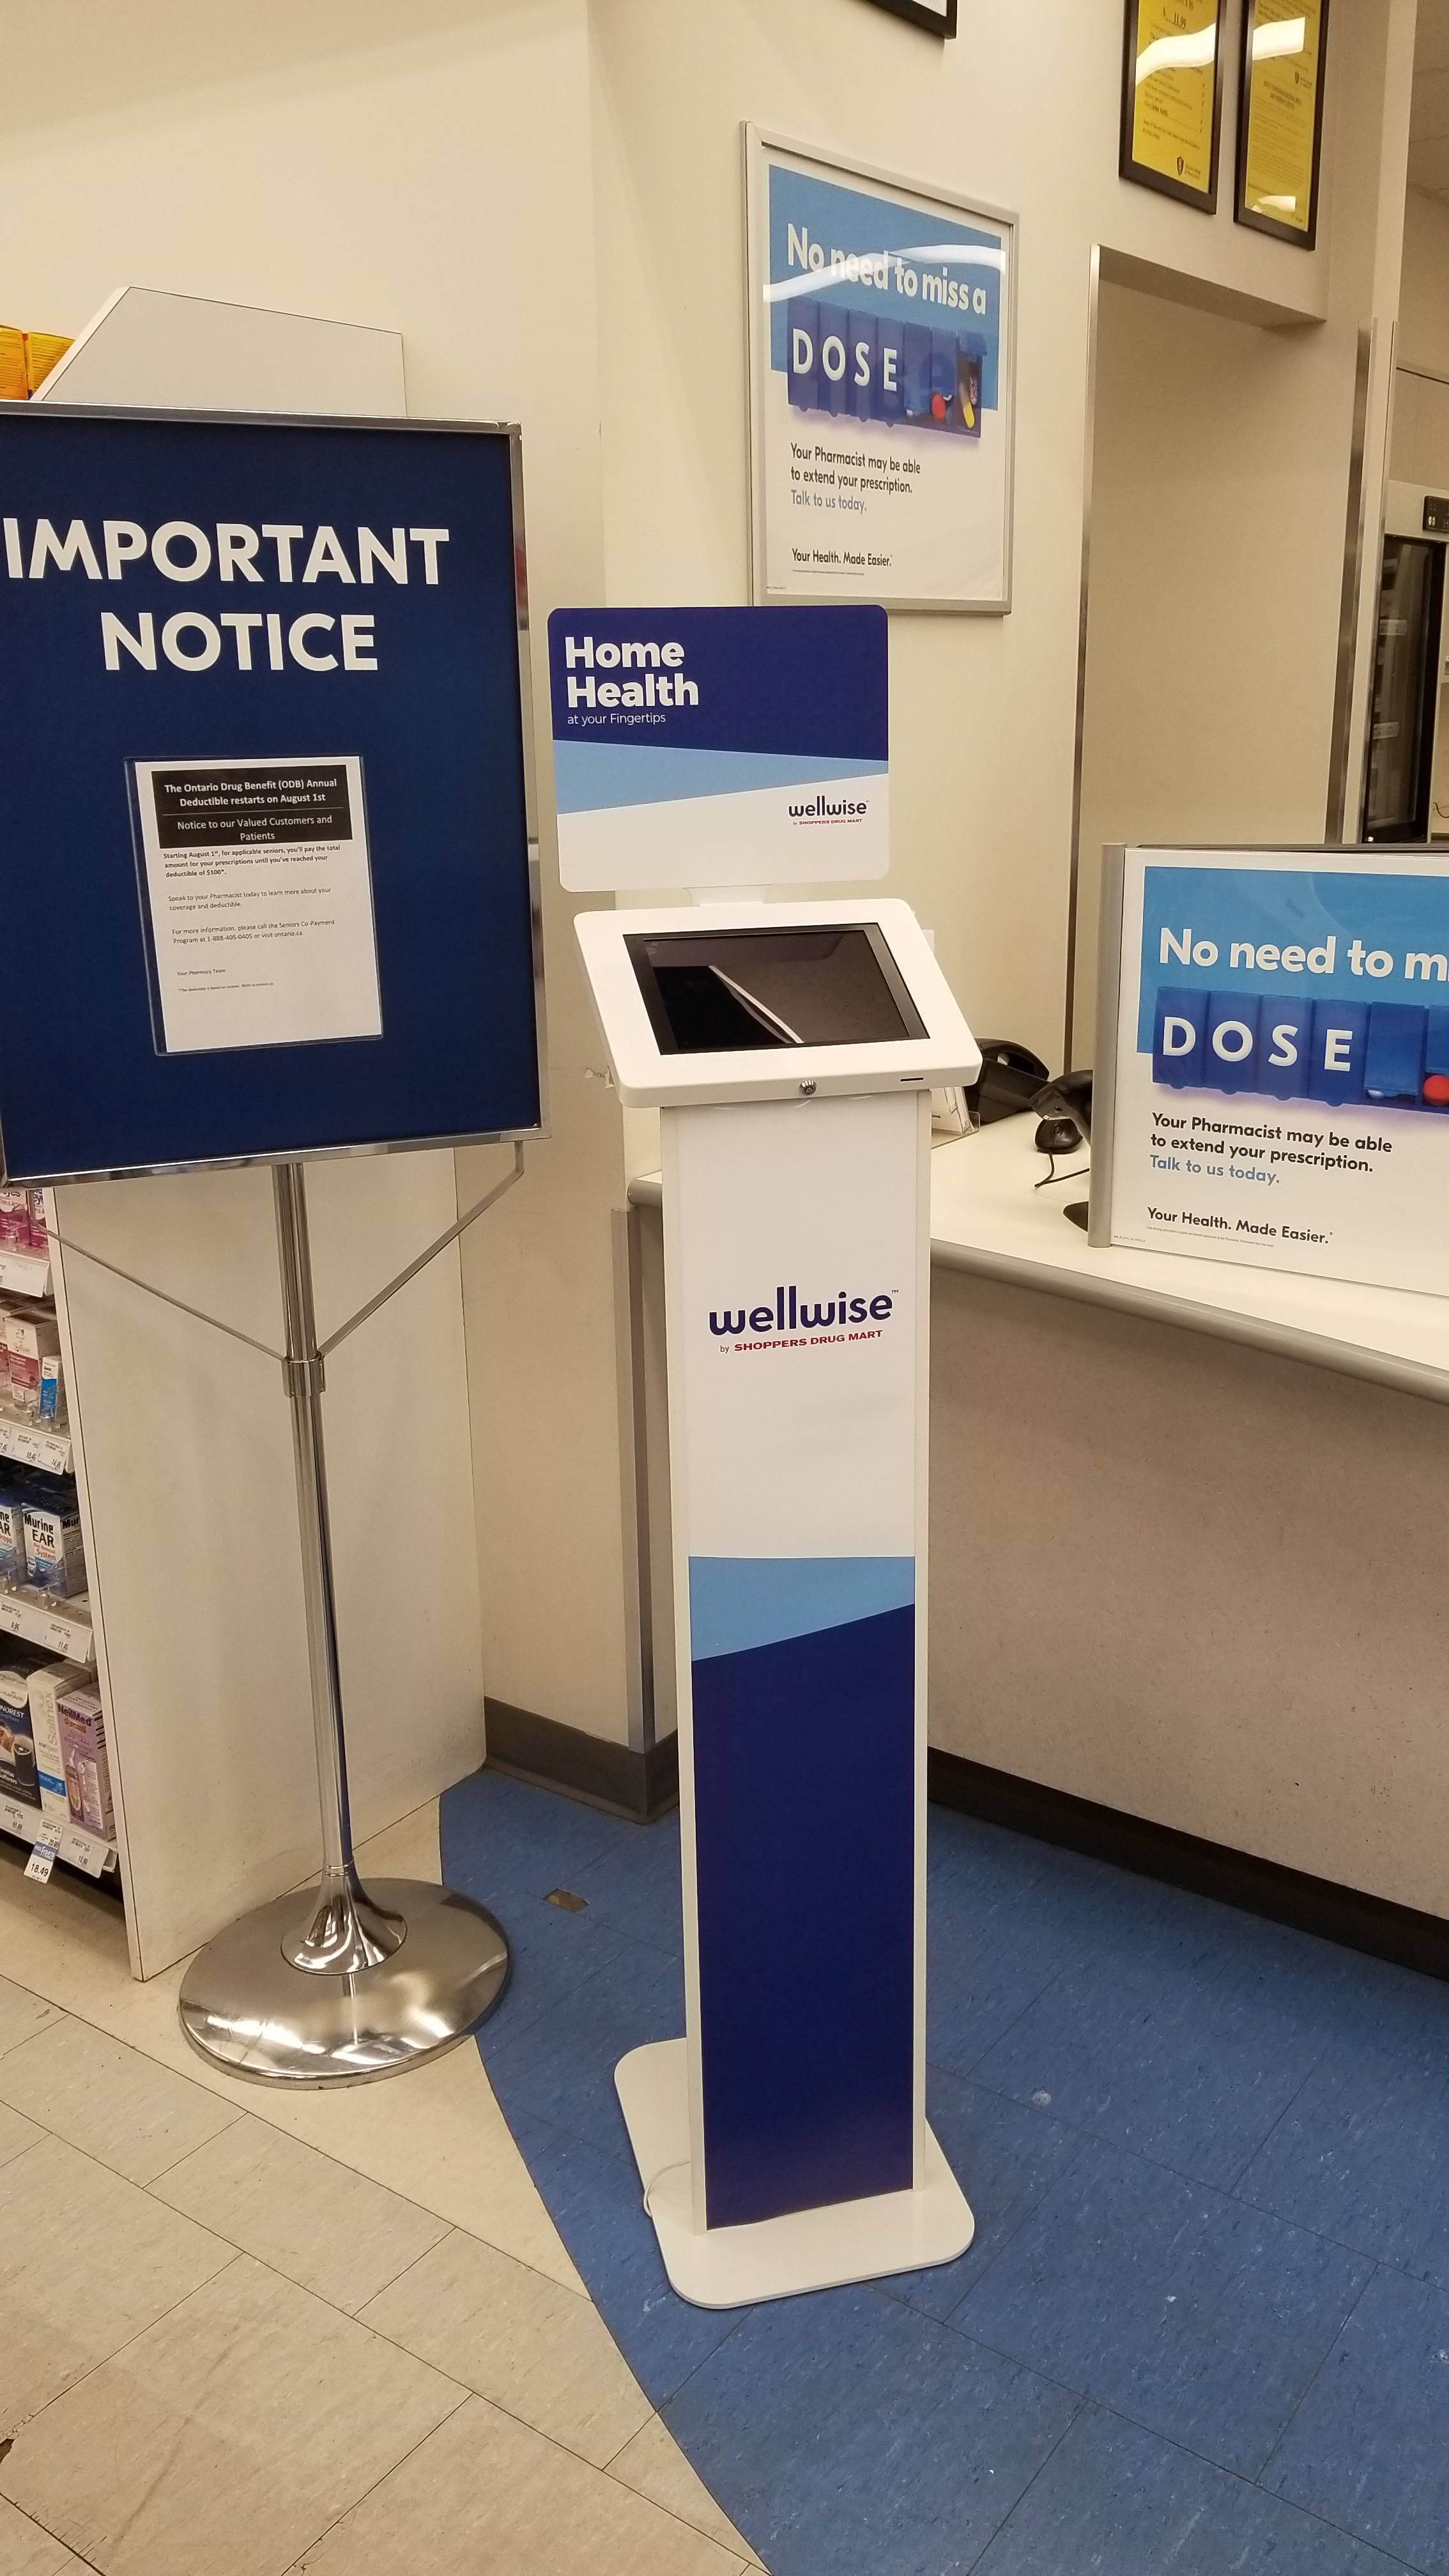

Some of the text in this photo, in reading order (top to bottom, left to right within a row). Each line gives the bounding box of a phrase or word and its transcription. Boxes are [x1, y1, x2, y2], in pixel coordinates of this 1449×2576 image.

[788, 223, 986, 314] No need to miss a
[791, 442, 921, 473] Your Pharmacist may be able
[791, 466, 912, 494] to extend your prescription.
[791, 489, 867, 514] Talk to us today.
[3, 518, 450, 585] IMPORTANT
[792, 548, 892, 567] Your Health. Made Easier.
[101, 611, 378, 671] NOTICE
[565, 636, 685, 668] Home
[567, 673, 699, 708] Health
[567, 712, 666, 727] at your Fingertips
[164, 778, 337, 793] The Ontario Drug Benefit (ODB) Annual
[180, 796, 228, 807] Deductible
[231, 796, 264, 805] restarts
[280, 794, 310, 804] August
[788, 795, 867, 816] wellwise
[178, 820, 206, 830] Notice
[208, 820, 218, 829] to
[237, 818, 267, 827] Valued
[270, 816, 314, 825] Customers
[316, 815, 332, 824] and
[240, 832, 275, 841] Patients
[1160, 927, 1218, 967] No
[1229, 935, 1337, 974] need
[1347, 939, 1393, 977] to
[1152, 1112, 1392, 1153] Your Pharmacist may be able
[1151, 1133, 1374, 1172] to extend your prescription.
[1150, 1154, 1280, 1186] Talk to us today.
[1147, 1207, 1177, 1222] Your
[1182, 1211, 1232, 1230] Health.
[1236, 1219, 1277, 1236] Made
[709, 1285, 893, 1335] wellwise
[719, 1330, 883, 1354] by SHOPPERS DRUG MART
[24, 1512, 54, 1535] Murine
[32, 1529, 55, 1548] EAR
[45, 1690, 57, 1746] Salinex
[57, 1703, 92, 1726] NeilMed
[31, 1863, 49, 1877] 18.49
